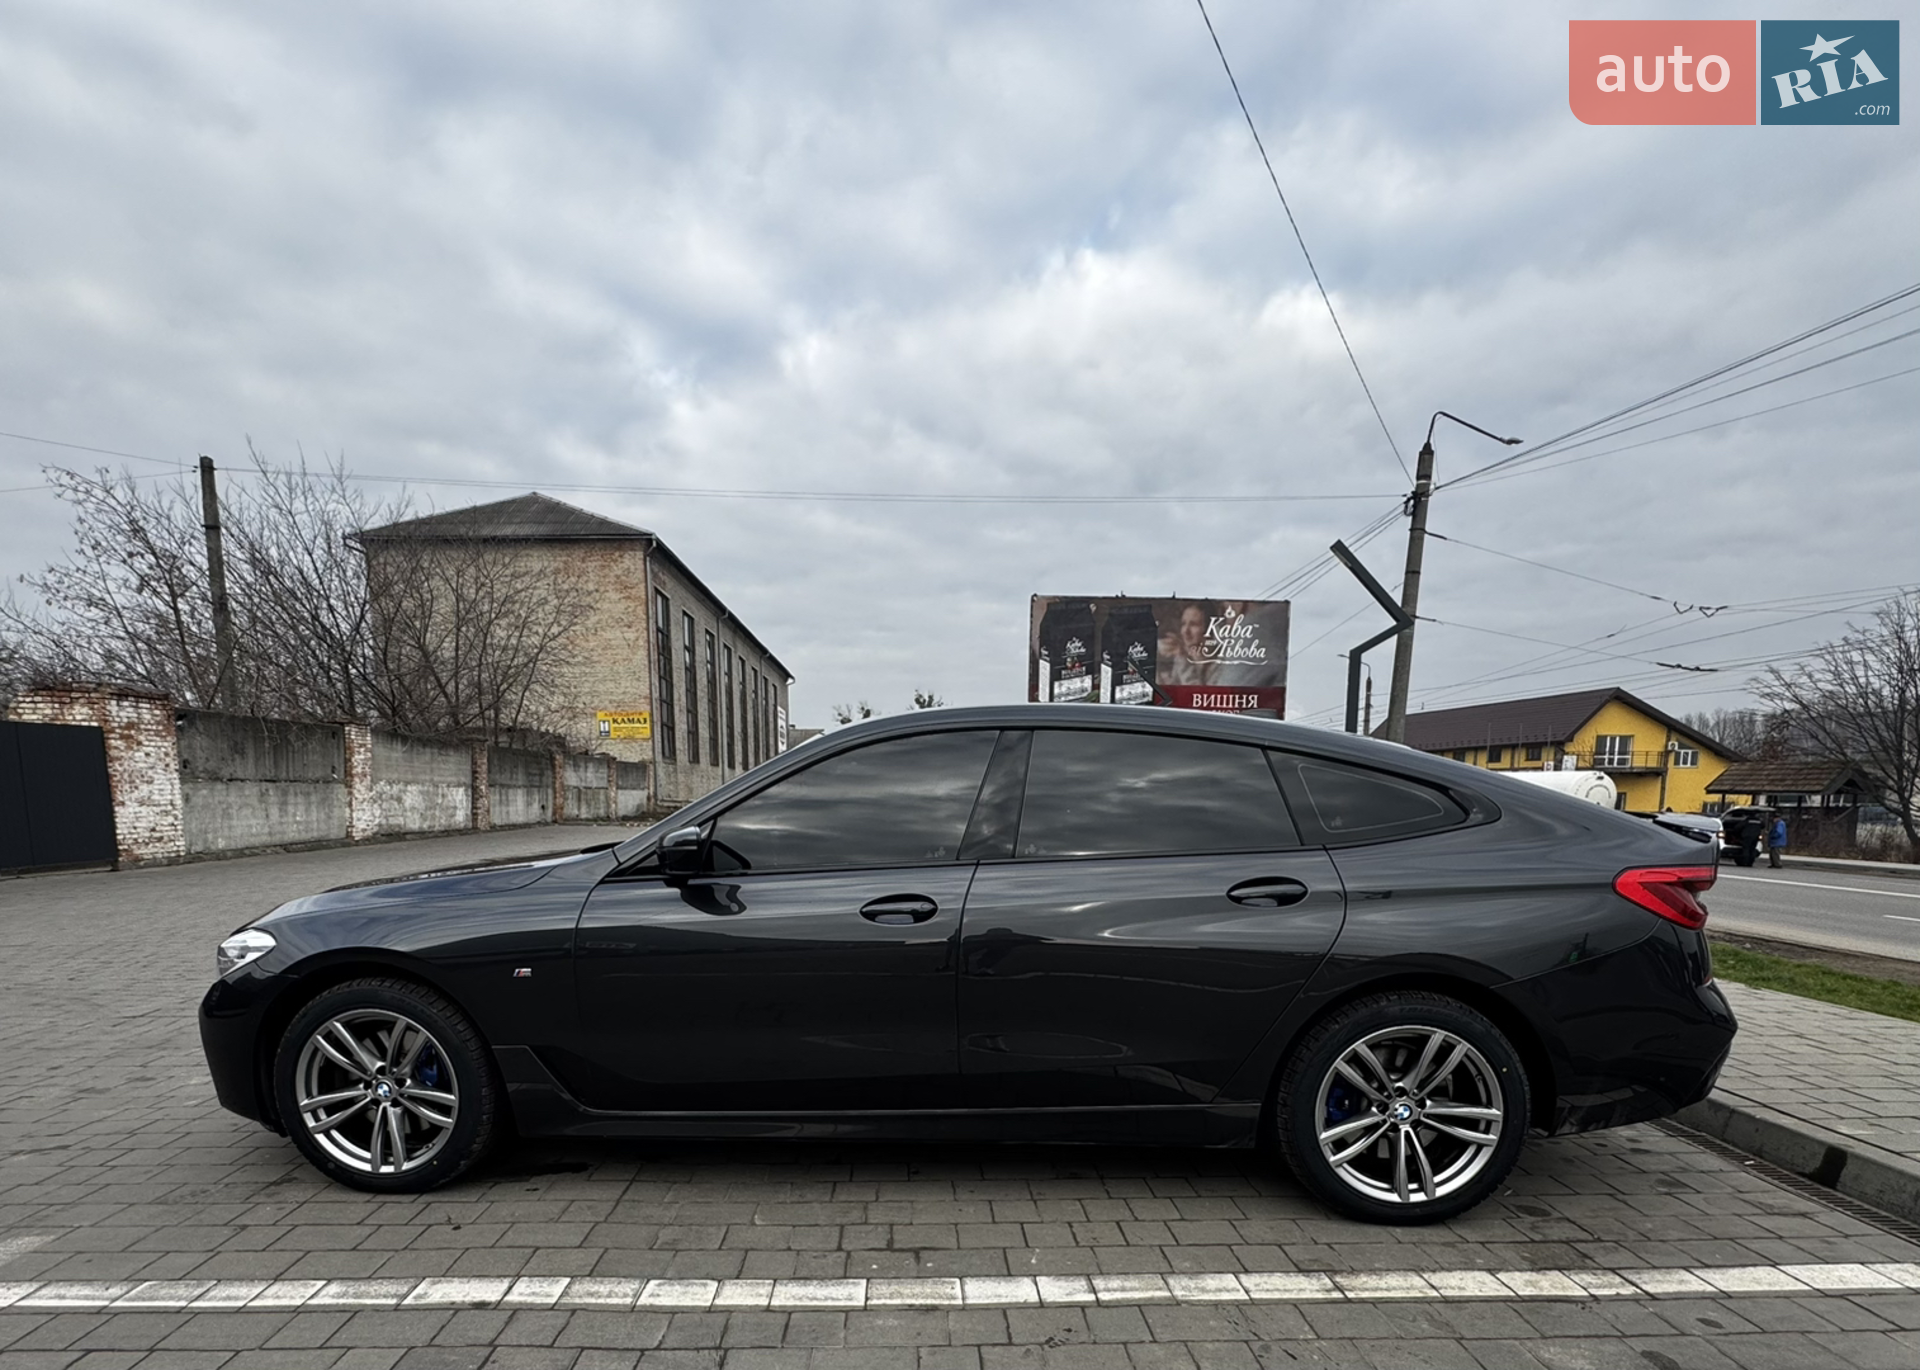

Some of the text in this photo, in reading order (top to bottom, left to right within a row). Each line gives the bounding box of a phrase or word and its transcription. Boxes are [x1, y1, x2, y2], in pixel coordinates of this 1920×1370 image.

[1203, 613, 1254, 639] Кава
[1202, 638, 1266, 658] Львова
[1191, 693, 1259, 709] ВИШНЯ
[611, 717, 648, 725] КАМАЗ
